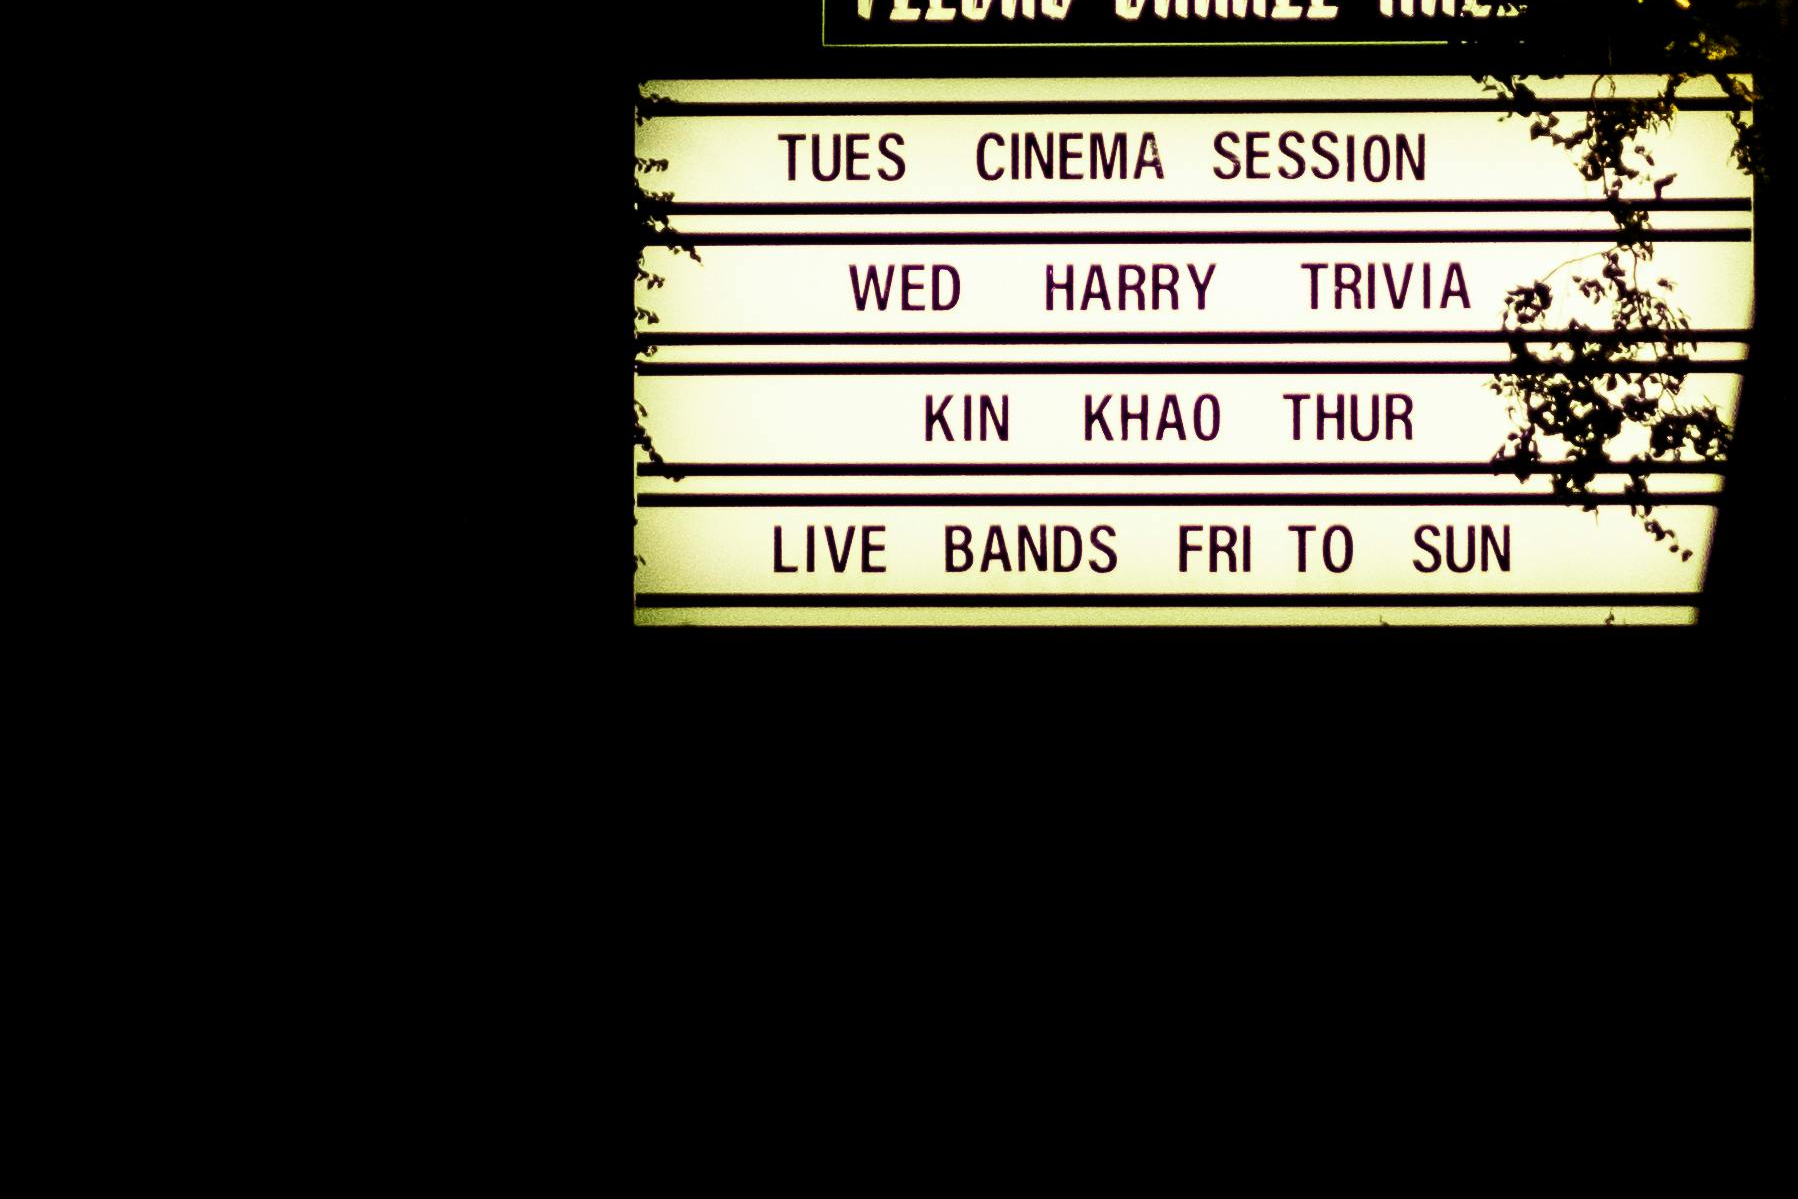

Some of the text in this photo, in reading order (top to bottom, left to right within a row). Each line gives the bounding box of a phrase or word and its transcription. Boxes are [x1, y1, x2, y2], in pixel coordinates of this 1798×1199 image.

[778, 131, 1425, 182] TUES CINEMA SESSION
[850, 263, 1470, 311] WED HARRY TRIVIA
[926, 394, 1413, 441] KIN KHAO THUR
[774, 525, 1510, 573] LIVE BANDS FRI TO SUN
